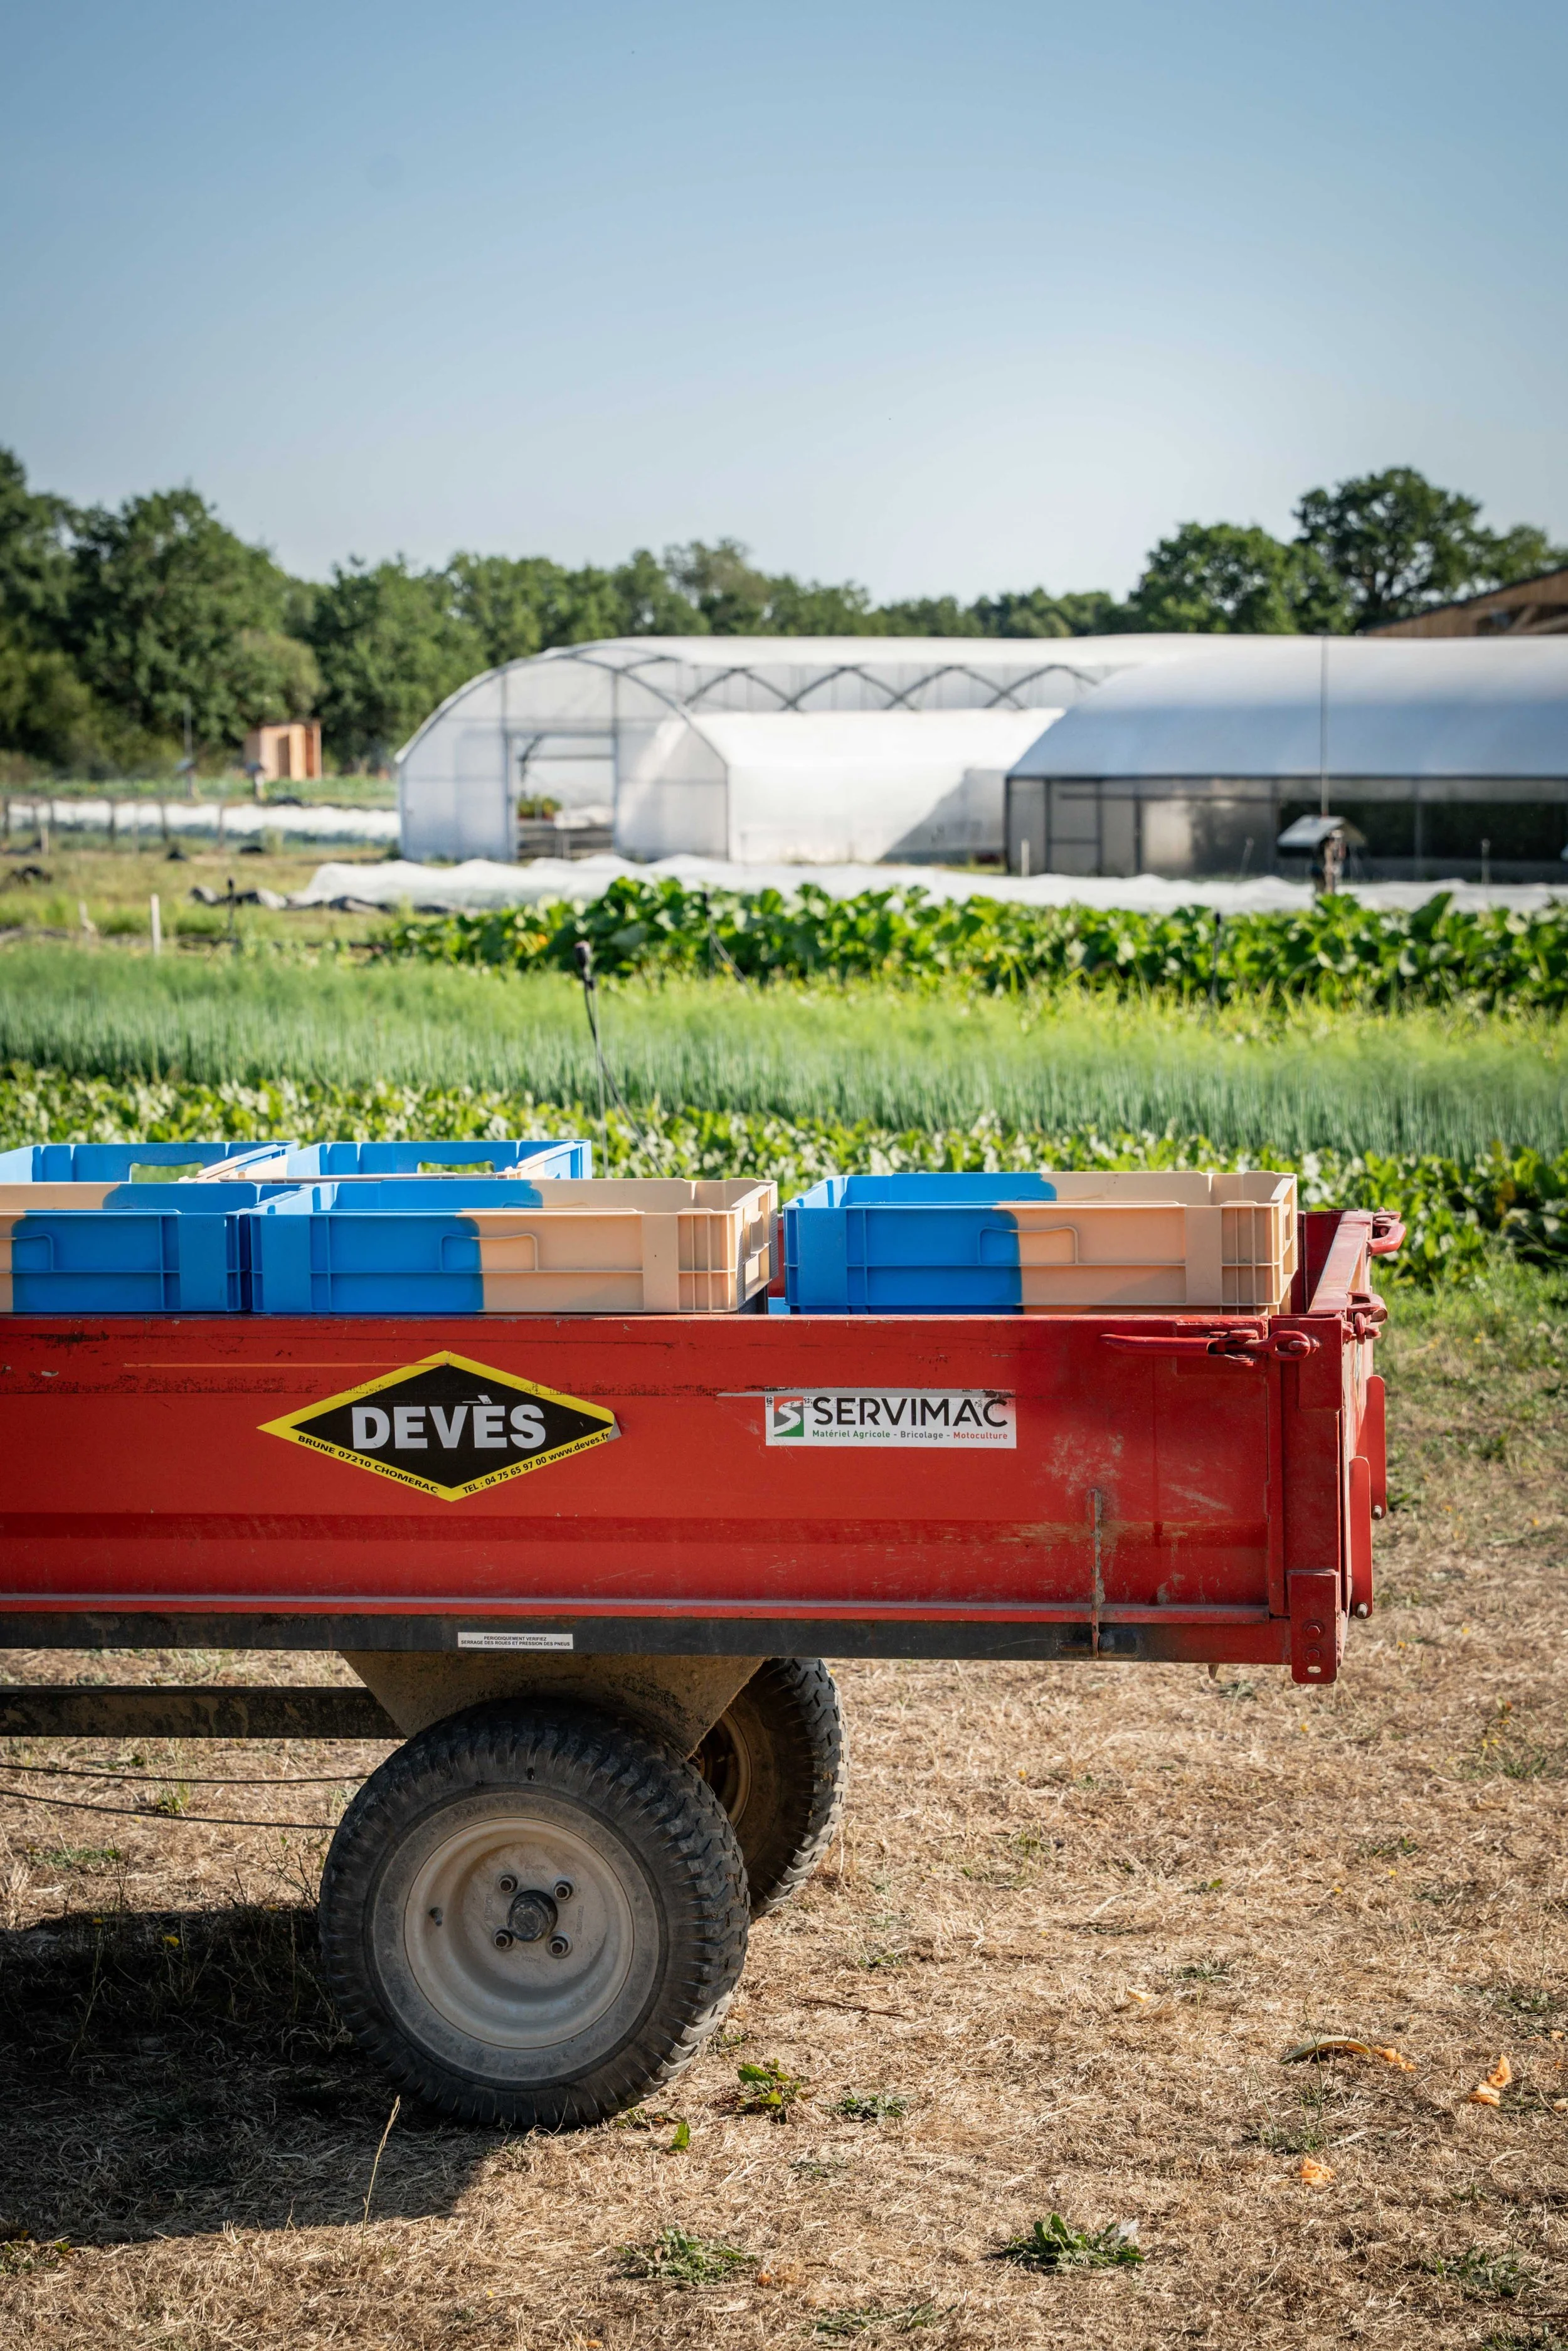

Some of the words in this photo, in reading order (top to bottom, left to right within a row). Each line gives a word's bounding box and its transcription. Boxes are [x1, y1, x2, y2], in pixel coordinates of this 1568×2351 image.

[352, 1395, 546, 1449] DEVÈS
[812, 1430, 850, 1438] Matériel
[853, 1430, 891, 1438] Agricole
[901, 1431, 943, 1440] Bricolage
[953, 1431, 1008, 1440] Motoculture
[813, 1396, 1008, 1427] SERVIMAC
[298, 1435, 335, 1454] BRUNE
[338, 1450, 371, 1468] 07210
[374, 1465, 438, 1494] CHOMERAC
[462, 1483, 479, 1494] TEL
[485, 1475, 496, 1485] 04
[497, 1471, 509, 1480] 75
[511, 1466, 522, 1475] 65
[522, 1461, 533, 1470] 97
[536, 1456, 547, 1465] 00
[548, 1431, 610, 1461] www.deves.fr
